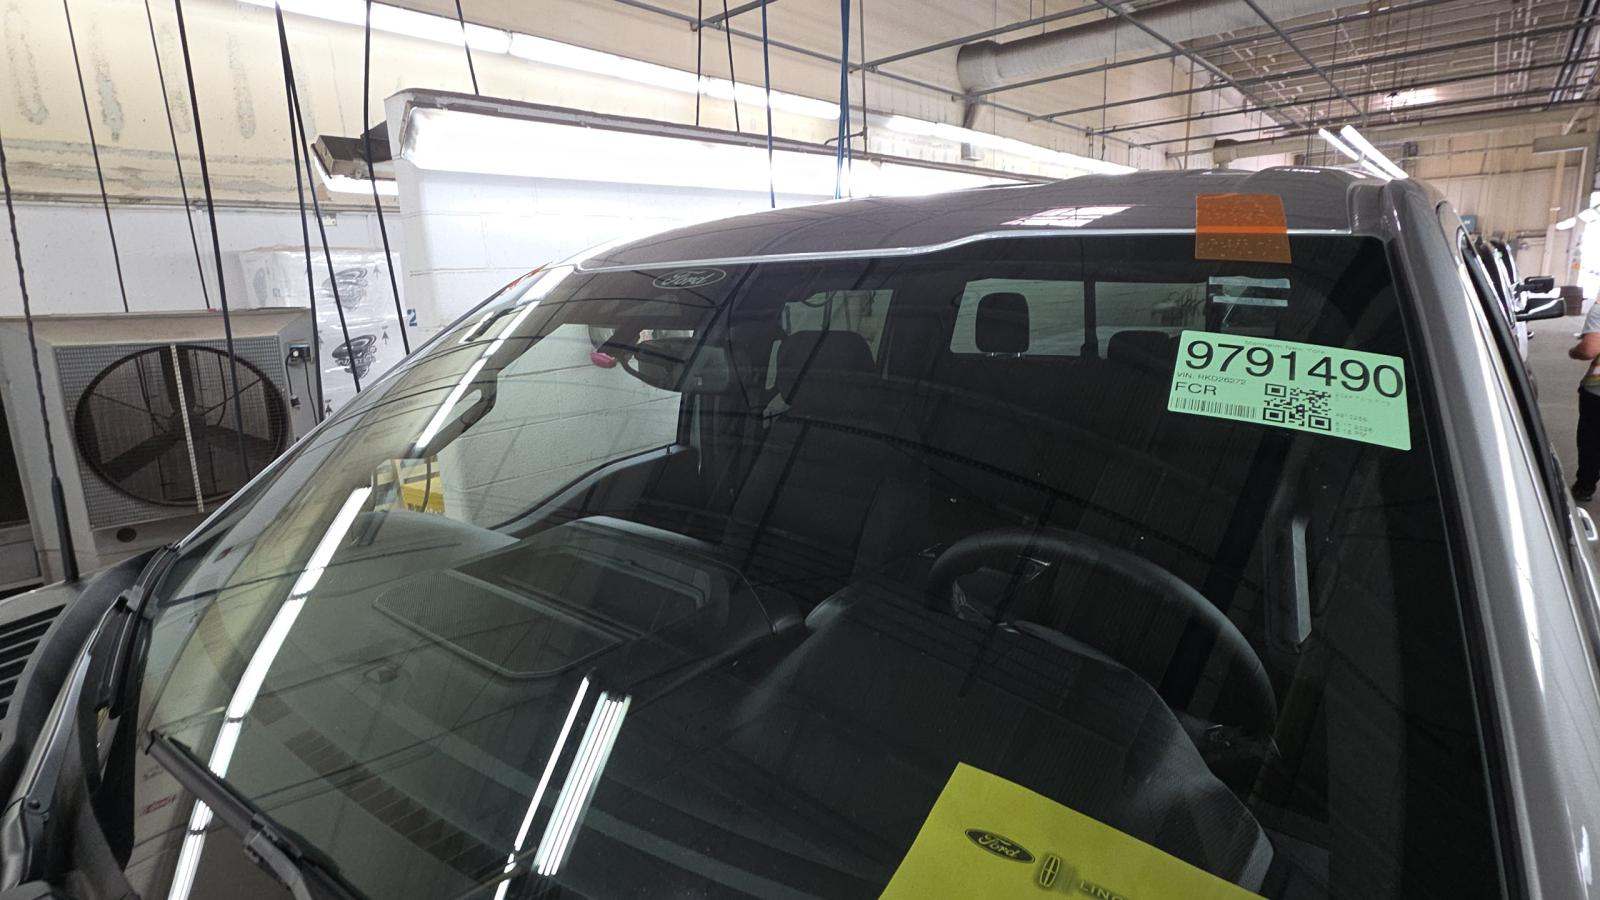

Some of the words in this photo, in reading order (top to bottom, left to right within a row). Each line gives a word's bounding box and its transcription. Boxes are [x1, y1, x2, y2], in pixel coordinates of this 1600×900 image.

[660, 269, 716, 287] Ford
[406, 308, 418, 327] 2
[1185, 340, 1404, 398] 9791490
[1175, 381, 1217, 396] FCR
[975, 832, 1024, 858] Ford
